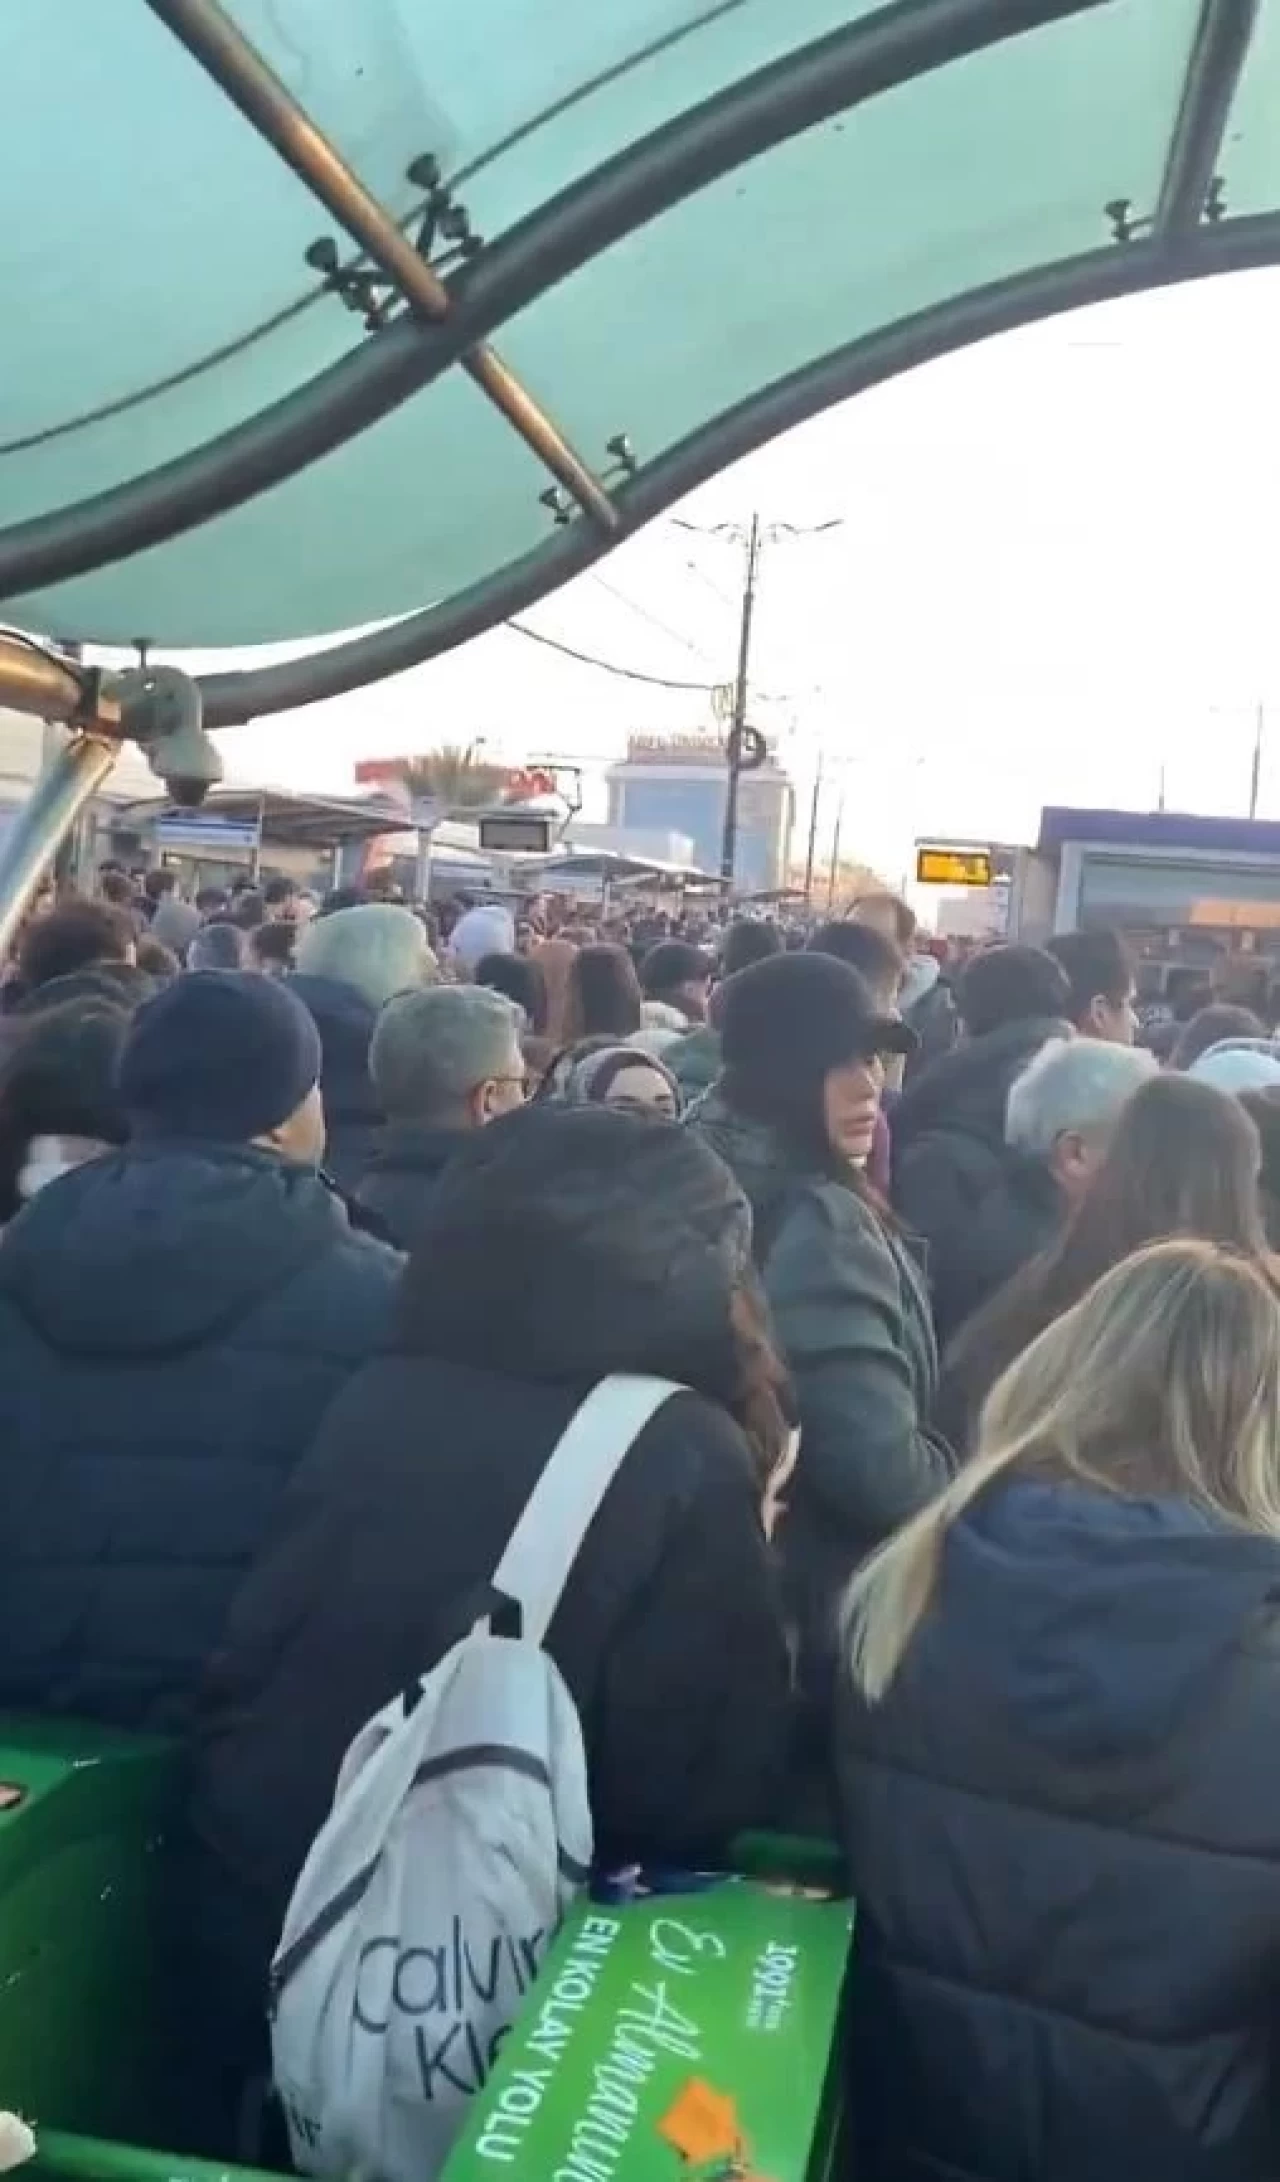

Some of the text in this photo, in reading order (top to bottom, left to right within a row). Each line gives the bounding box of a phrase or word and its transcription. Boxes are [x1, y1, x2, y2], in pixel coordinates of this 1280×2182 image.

[650, 1918, 726, 1976] Ev
[475, 1914, 622, 2163] EN KOLAY YOLU
